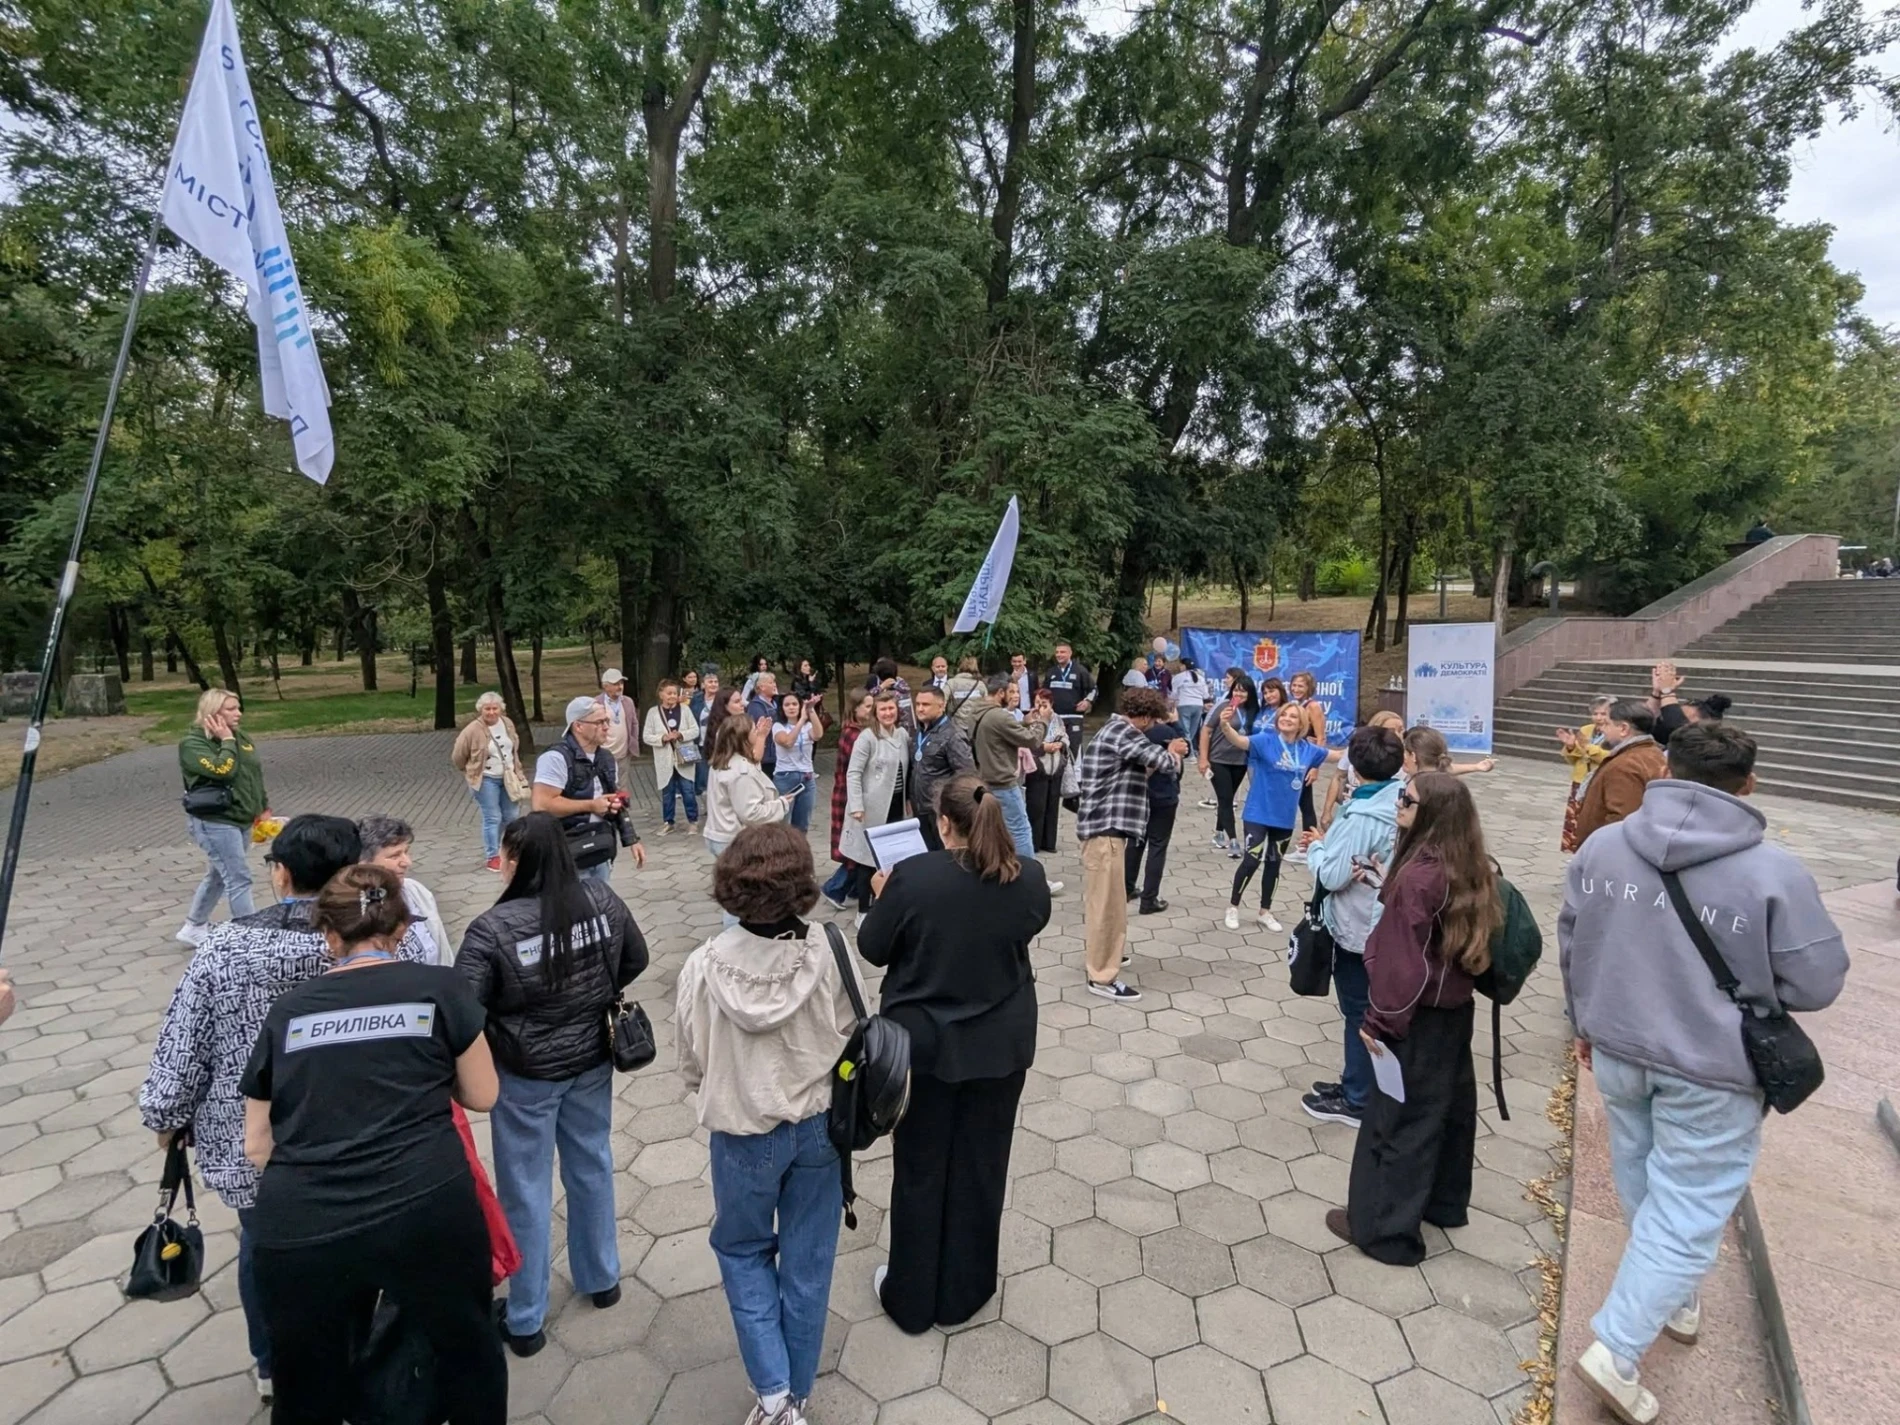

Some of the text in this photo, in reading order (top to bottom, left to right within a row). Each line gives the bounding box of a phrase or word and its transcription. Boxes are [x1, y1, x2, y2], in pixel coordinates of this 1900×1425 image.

[1440, 662, 1488, 670] КУЛЬТУРА
[1581, 878, 1748, 935] UKRANE
[310, 1013, 406, 1038] БРИЛІВКА
